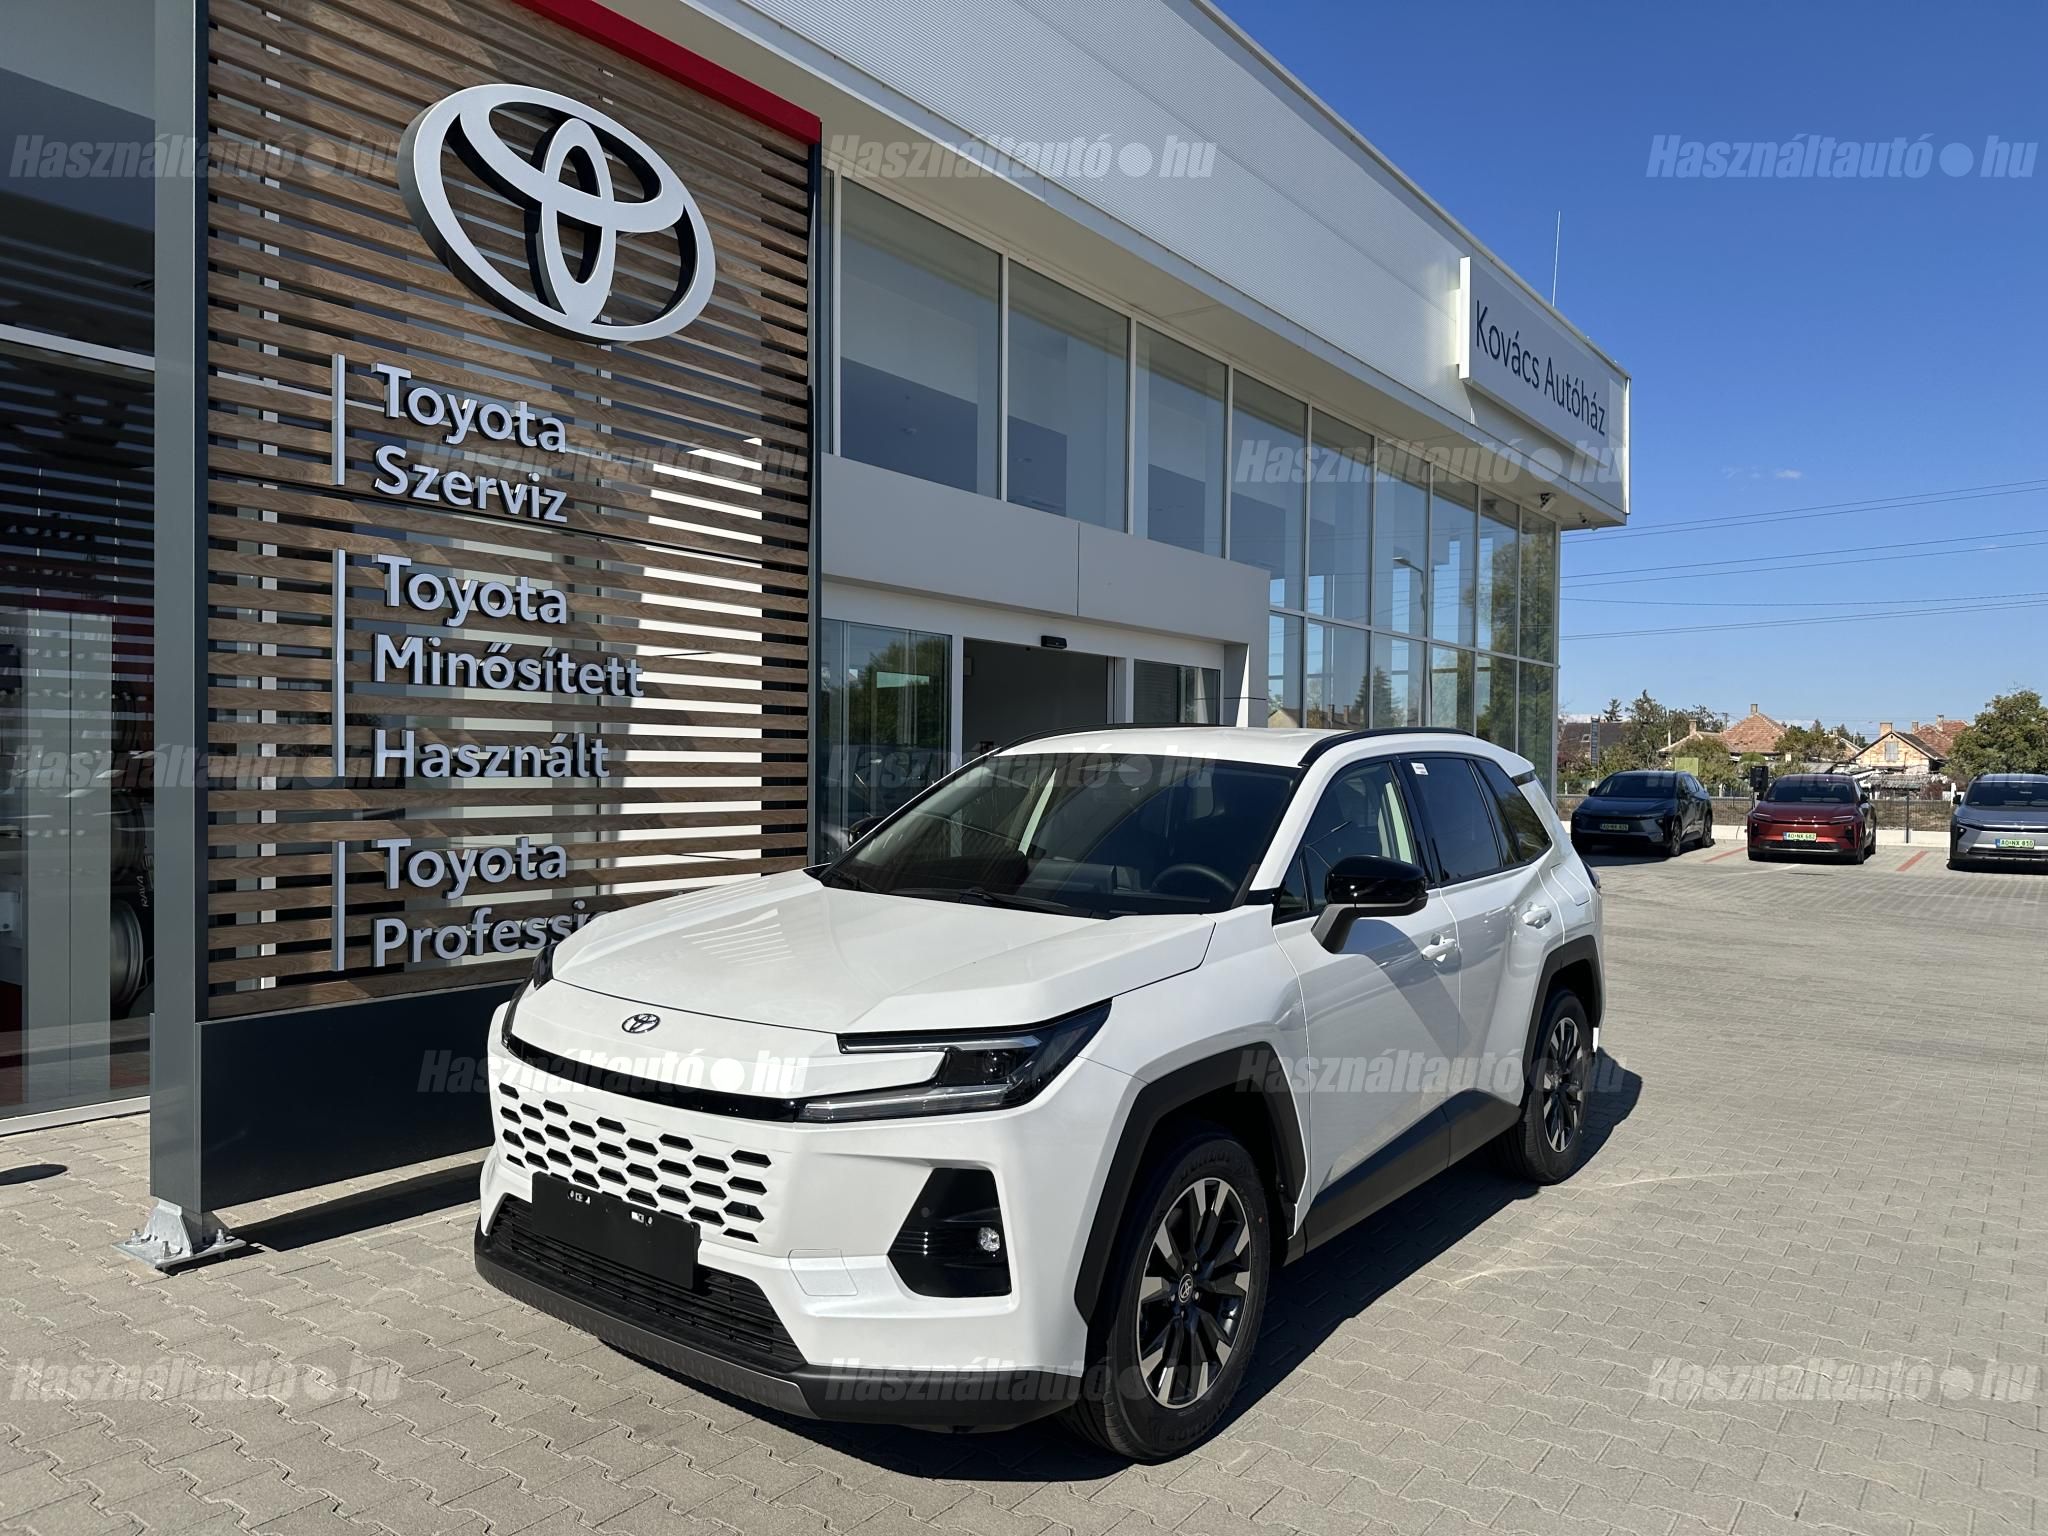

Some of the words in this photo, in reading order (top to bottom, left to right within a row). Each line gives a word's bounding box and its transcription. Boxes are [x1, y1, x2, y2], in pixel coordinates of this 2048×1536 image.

[1475, 300, 1540, 390] Kovács
[1544, 356, 1606, 437] Autóház
[371, 363, 566, 454] Toyota
[374, 445, 568, 523] Szerviz
[371, 554, 567, 627] Toyota
[373, 633, 644, 697] Minősített
[373, 729, 610, 778] Használt
[371, 837, 567, 900] Toyota
[371, 899, 608, 968] Professi
